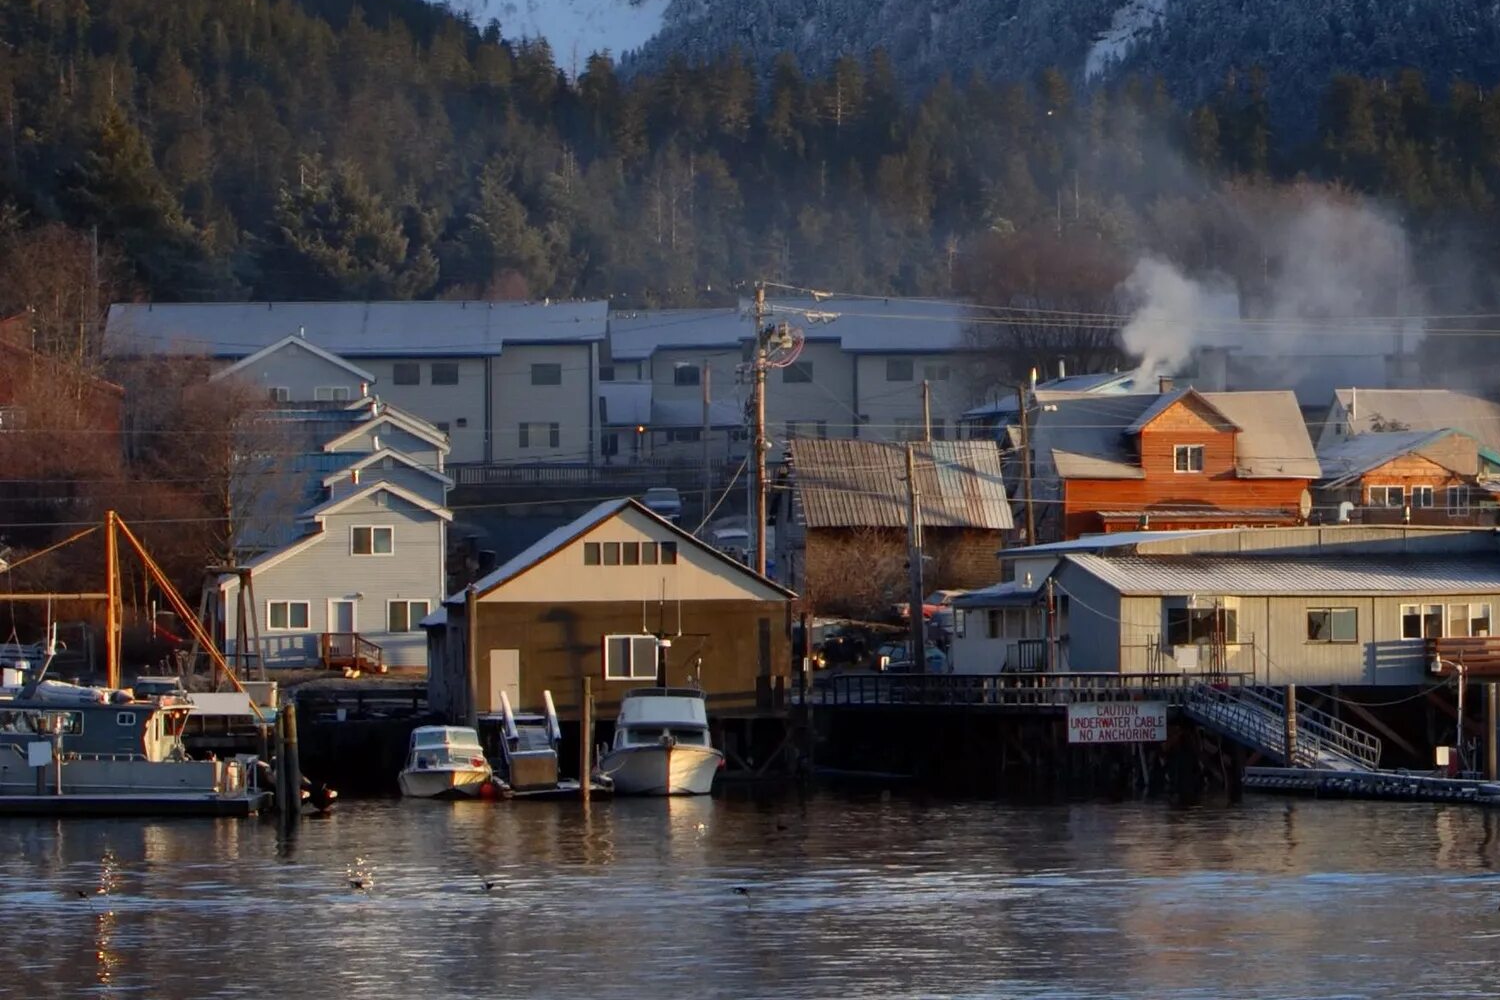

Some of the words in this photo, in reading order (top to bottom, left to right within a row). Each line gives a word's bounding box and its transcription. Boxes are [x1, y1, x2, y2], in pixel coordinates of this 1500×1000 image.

[1096, 705, 1138, 716] CAUTION
[1070, 717, 1130, 729] UNDERWATER
[1134, 716, 1164, 728] CABLE
[1079, 729, 1093, 741] NO
[1098, 728, 1156, 740] ANCHORING
